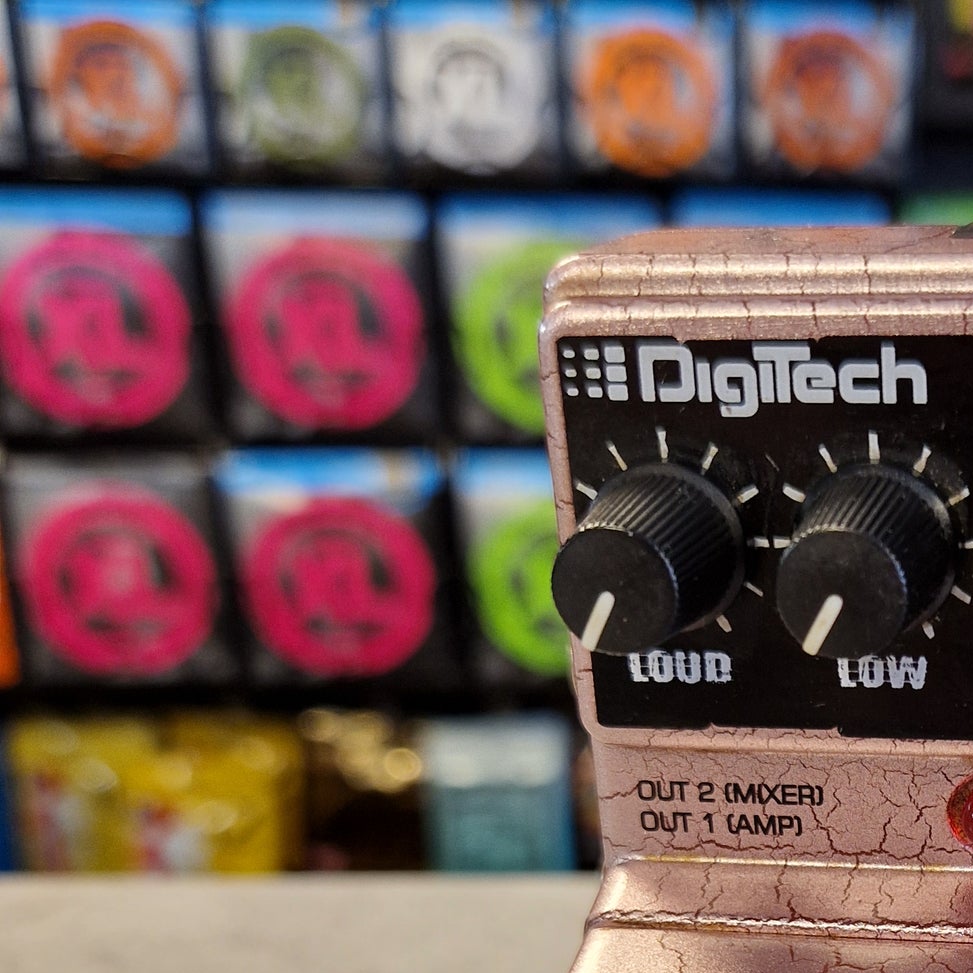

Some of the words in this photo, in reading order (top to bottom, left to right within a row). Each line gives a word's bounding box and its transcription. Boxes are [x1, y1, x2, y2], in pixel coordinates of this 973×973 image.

[637, 341, 928, 418] DigiTech
[628, 650, 733, 684] LOUD
[838, 656, 928, 690] LOW
[637, 780, 689, 802] OUT
[698, 781, 716, 803] 2
[724, 782, 824, 806] (MIXER)
[640, 811, 693, 833] OUT
[703, 813, 714, 833] 1
[727, 812, 803, 836] (AMP)
